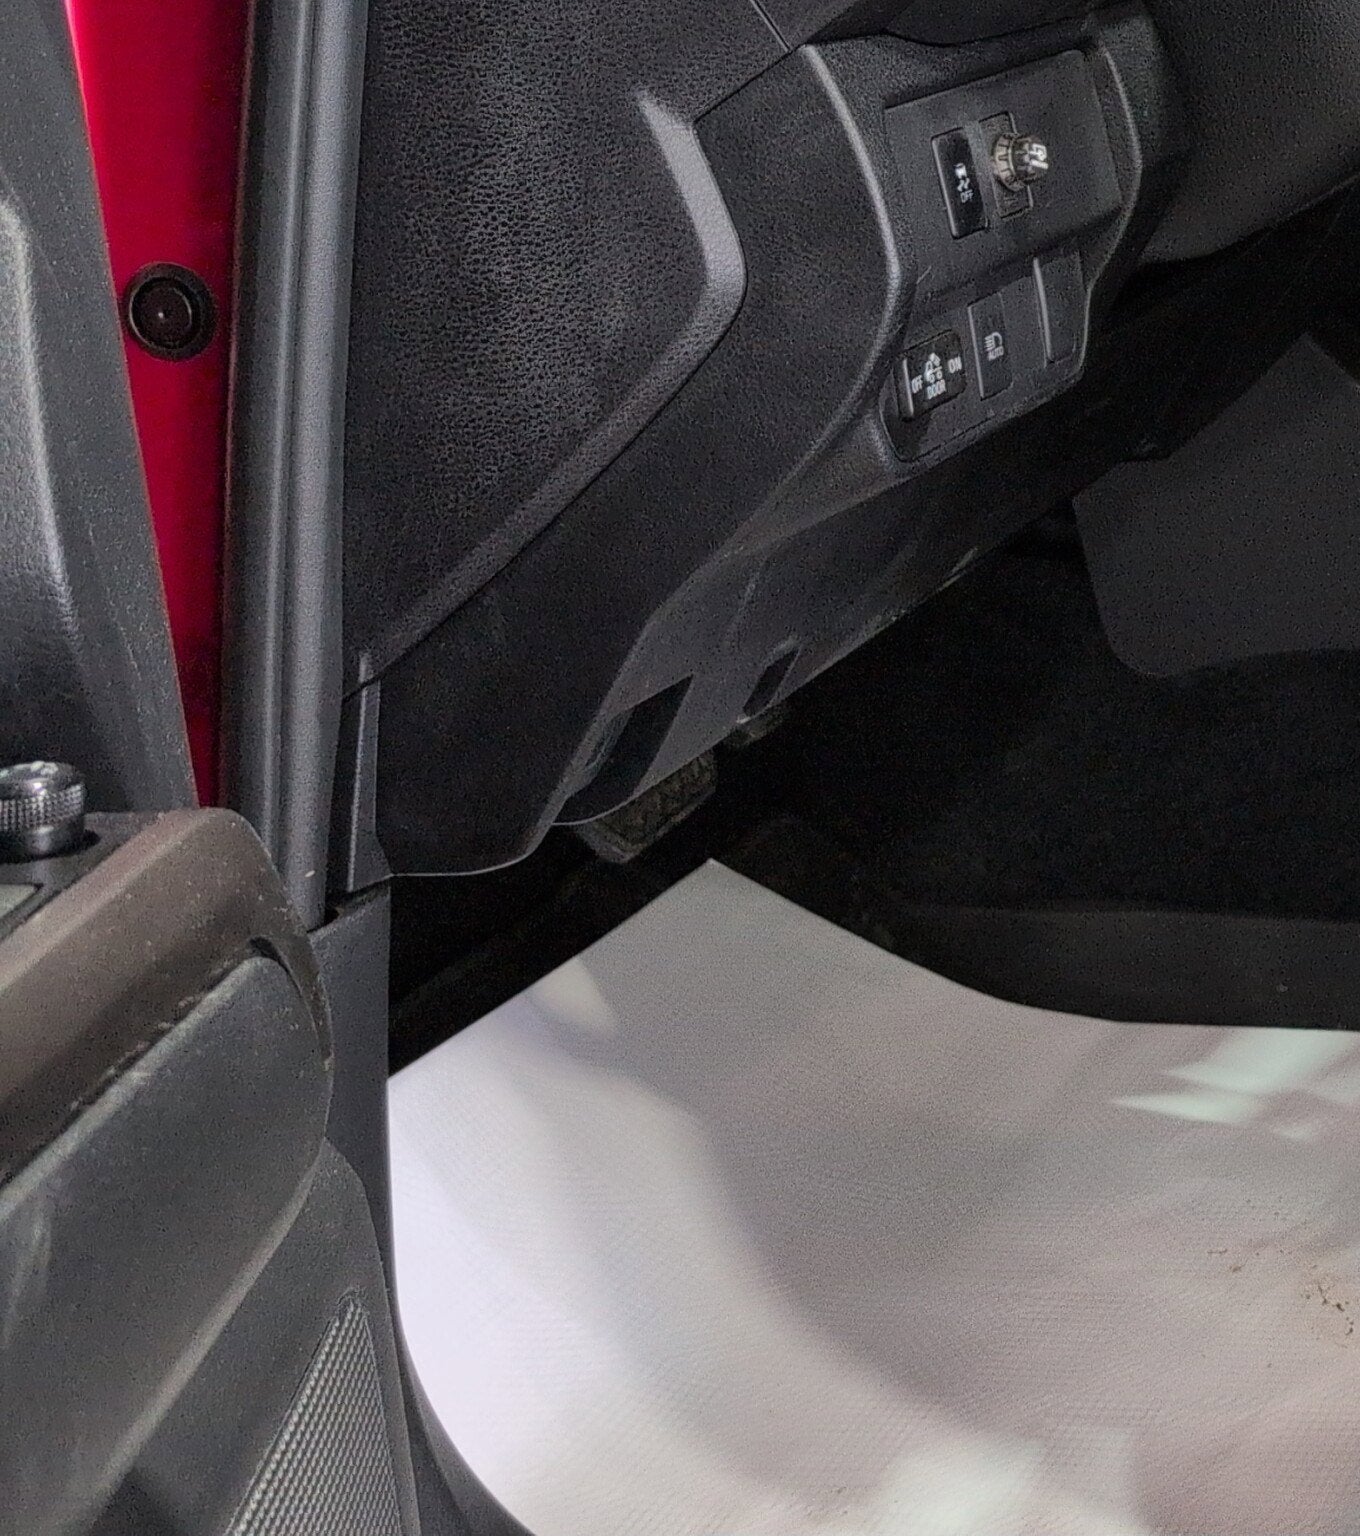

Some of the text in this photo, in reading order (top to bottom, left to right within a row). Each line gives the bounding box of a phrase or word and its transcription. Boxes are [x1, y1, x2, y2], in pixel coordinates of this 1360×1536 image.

[960, 188, 973, 204] OFF
[987, 346, 1004, 361] AUTO
[947, 355, 962, 373] ON
[911, 375, 923, 394] OFF
[927, 379, 946, 400] DOOR
